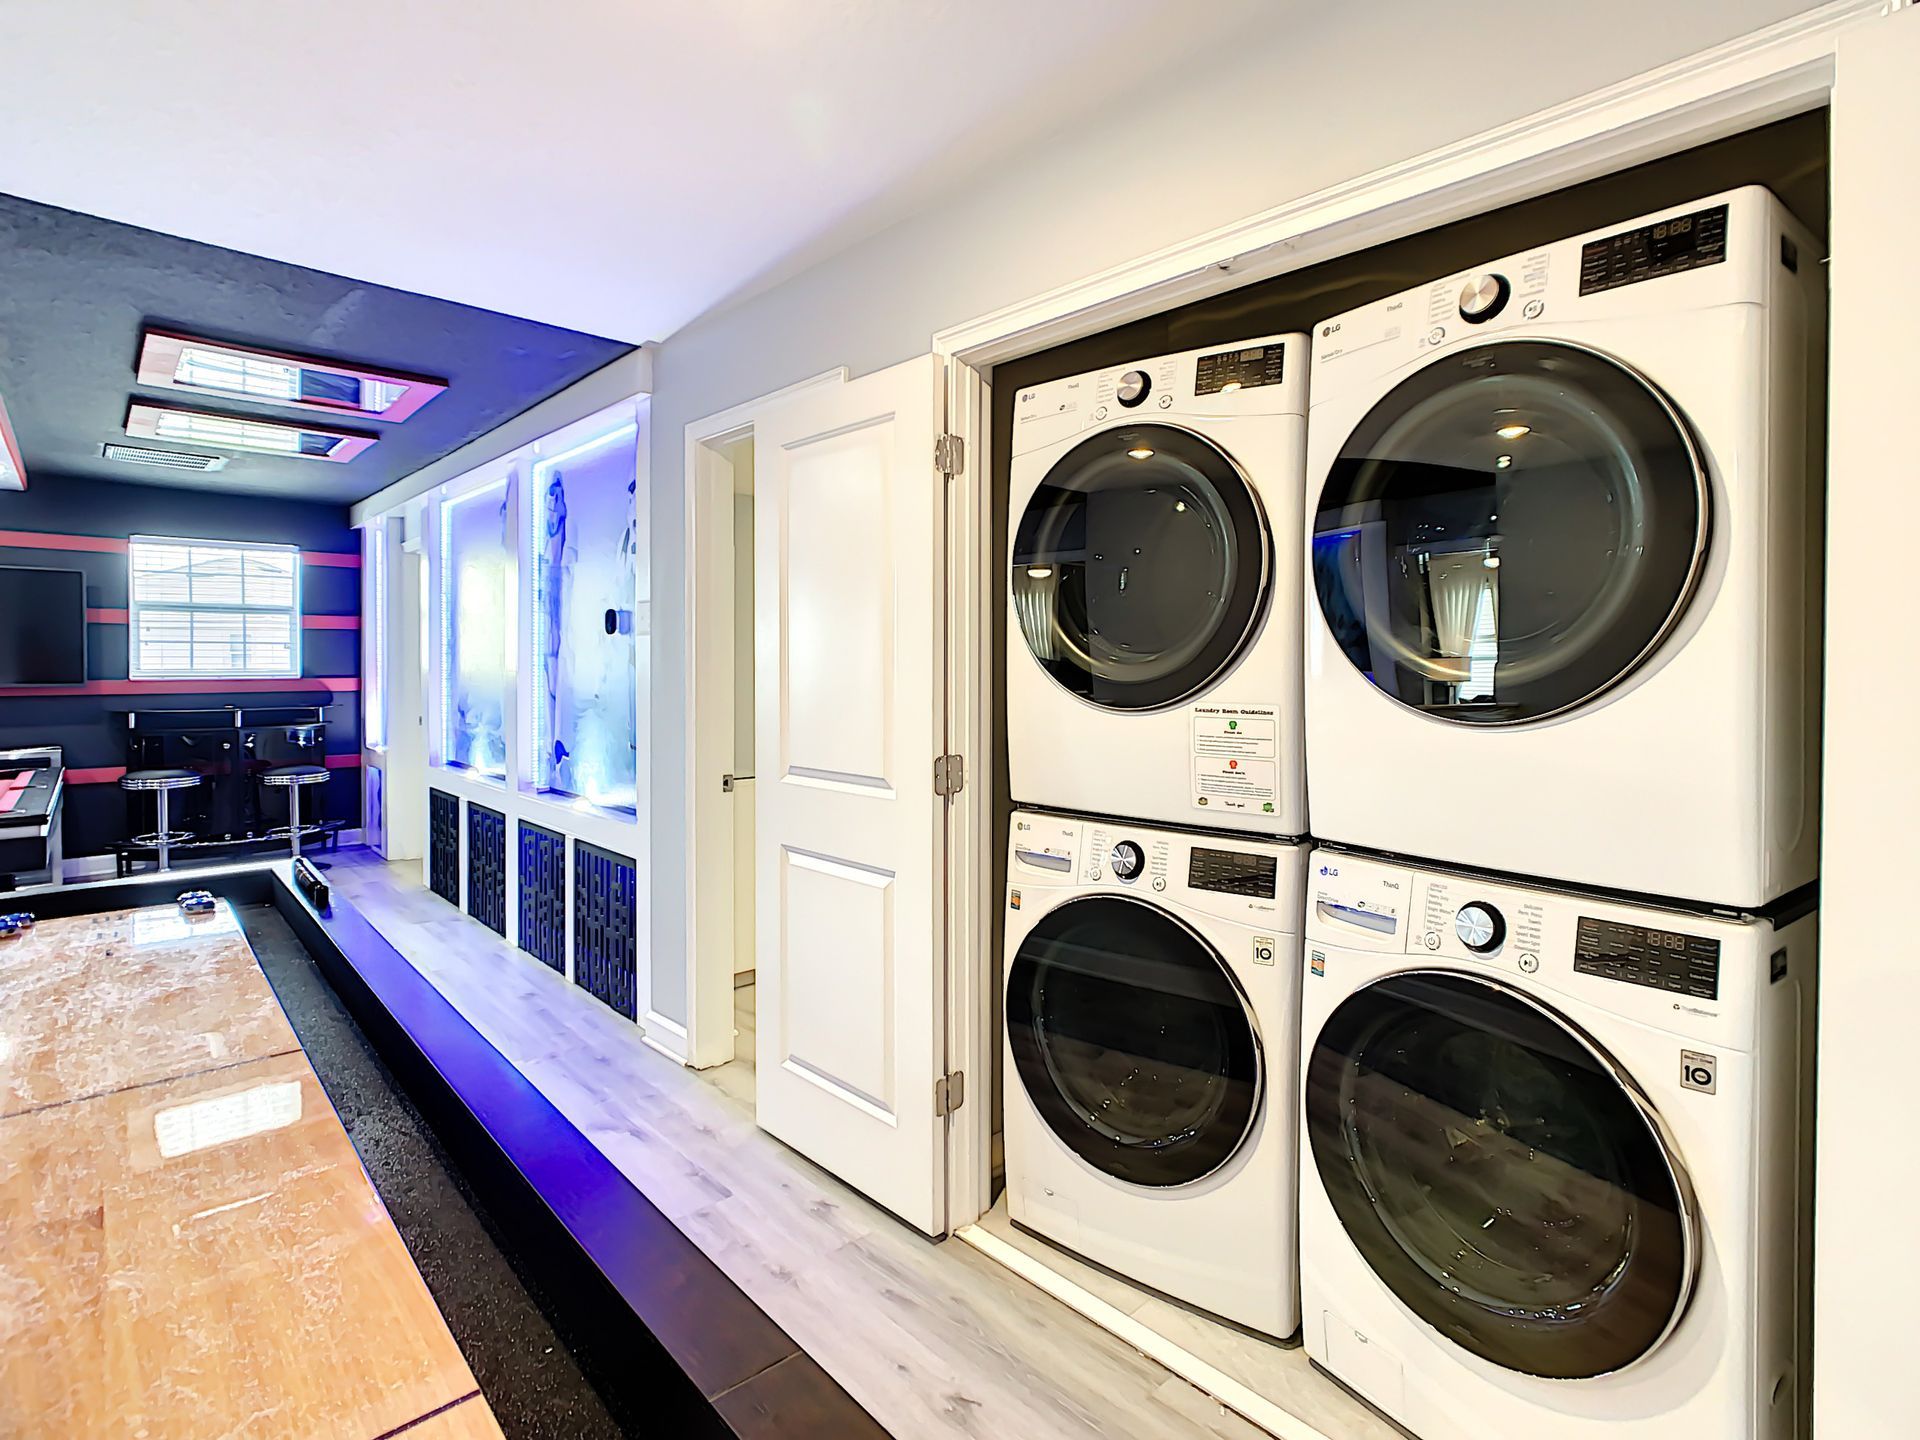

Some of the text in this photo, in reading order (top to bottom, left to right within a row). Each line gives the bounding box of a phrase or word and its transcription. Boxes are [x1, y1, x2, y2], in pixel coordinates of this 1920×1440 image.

[1383, 880, 1400, 890] ThinQ
[1256, 947, 1272, 960] 10
[1684, 1065, 1712, 1085] 10
